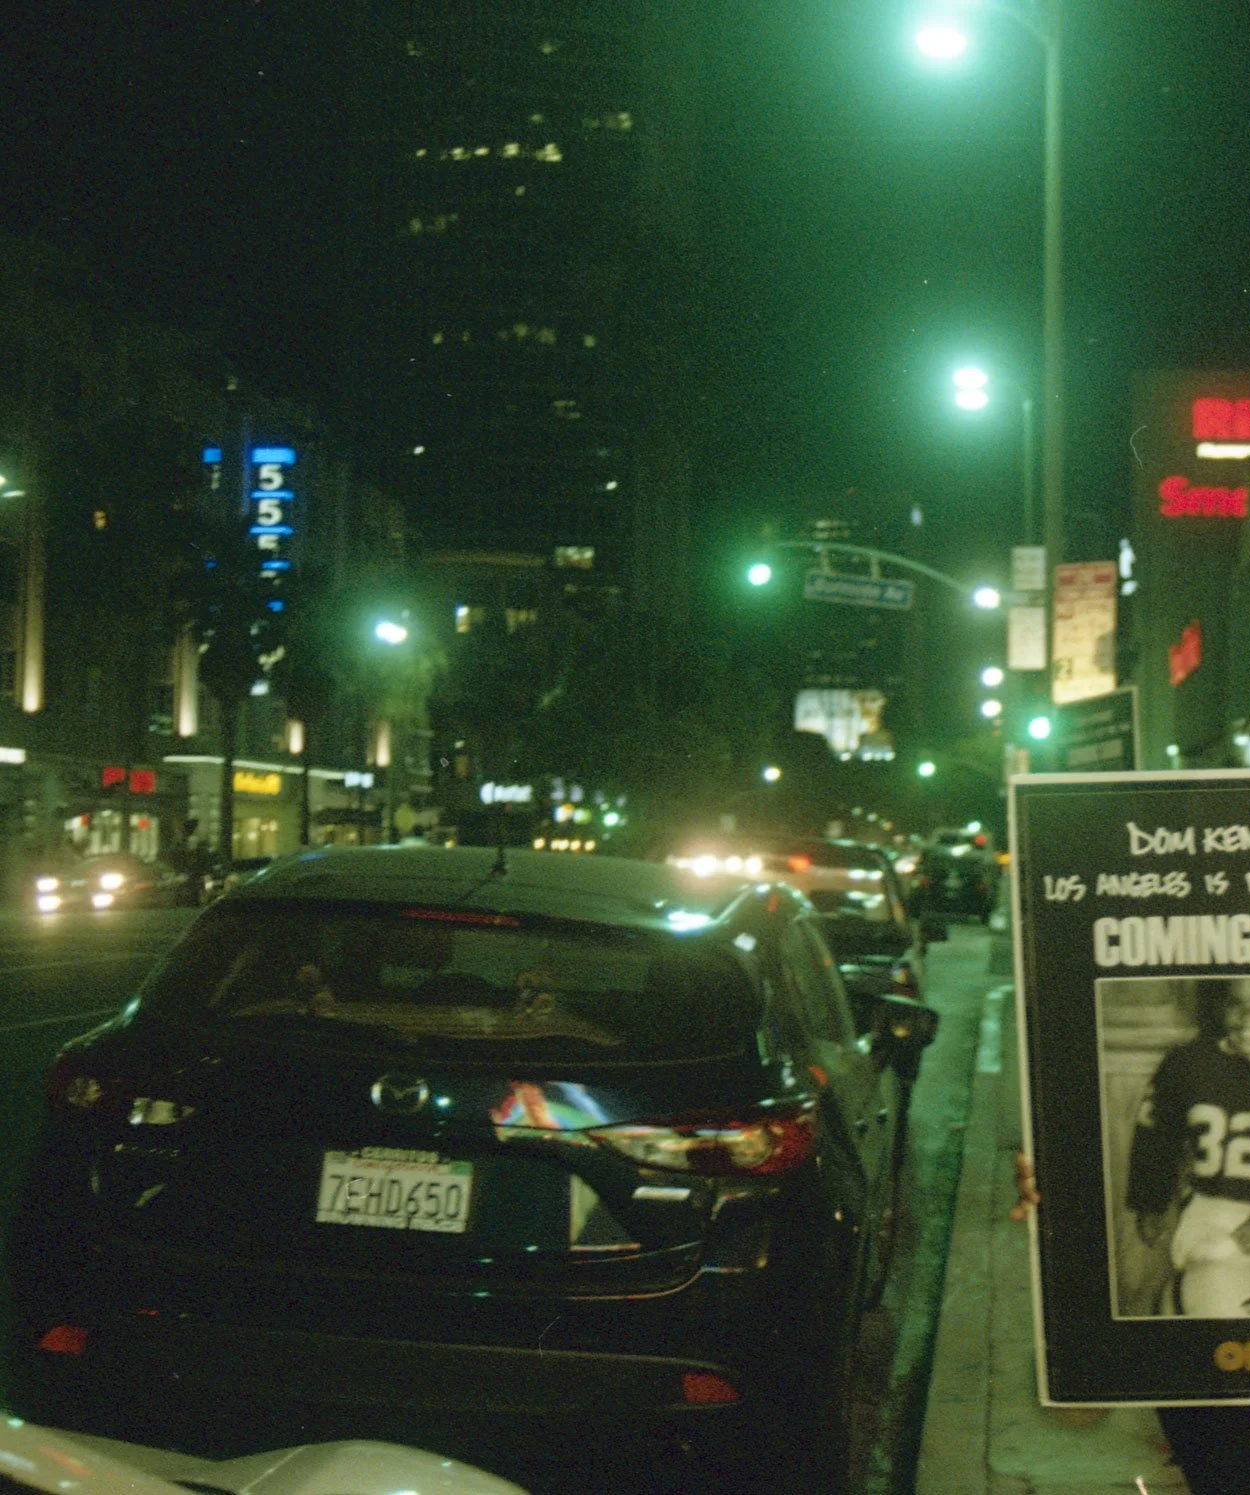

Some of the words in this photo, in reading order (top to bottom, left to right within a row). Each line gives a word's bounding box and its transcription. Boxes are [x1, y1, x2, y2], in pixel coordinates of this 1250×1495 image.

[1127, 822, 1196, 855] DOM
[1044, 874, 1086, 902] LOS
[1096, 872, 1192, 898] ANGELES
[1205, 871, 1229, 895] IS
[328, 1174, 464, 1219] 7EHD650
